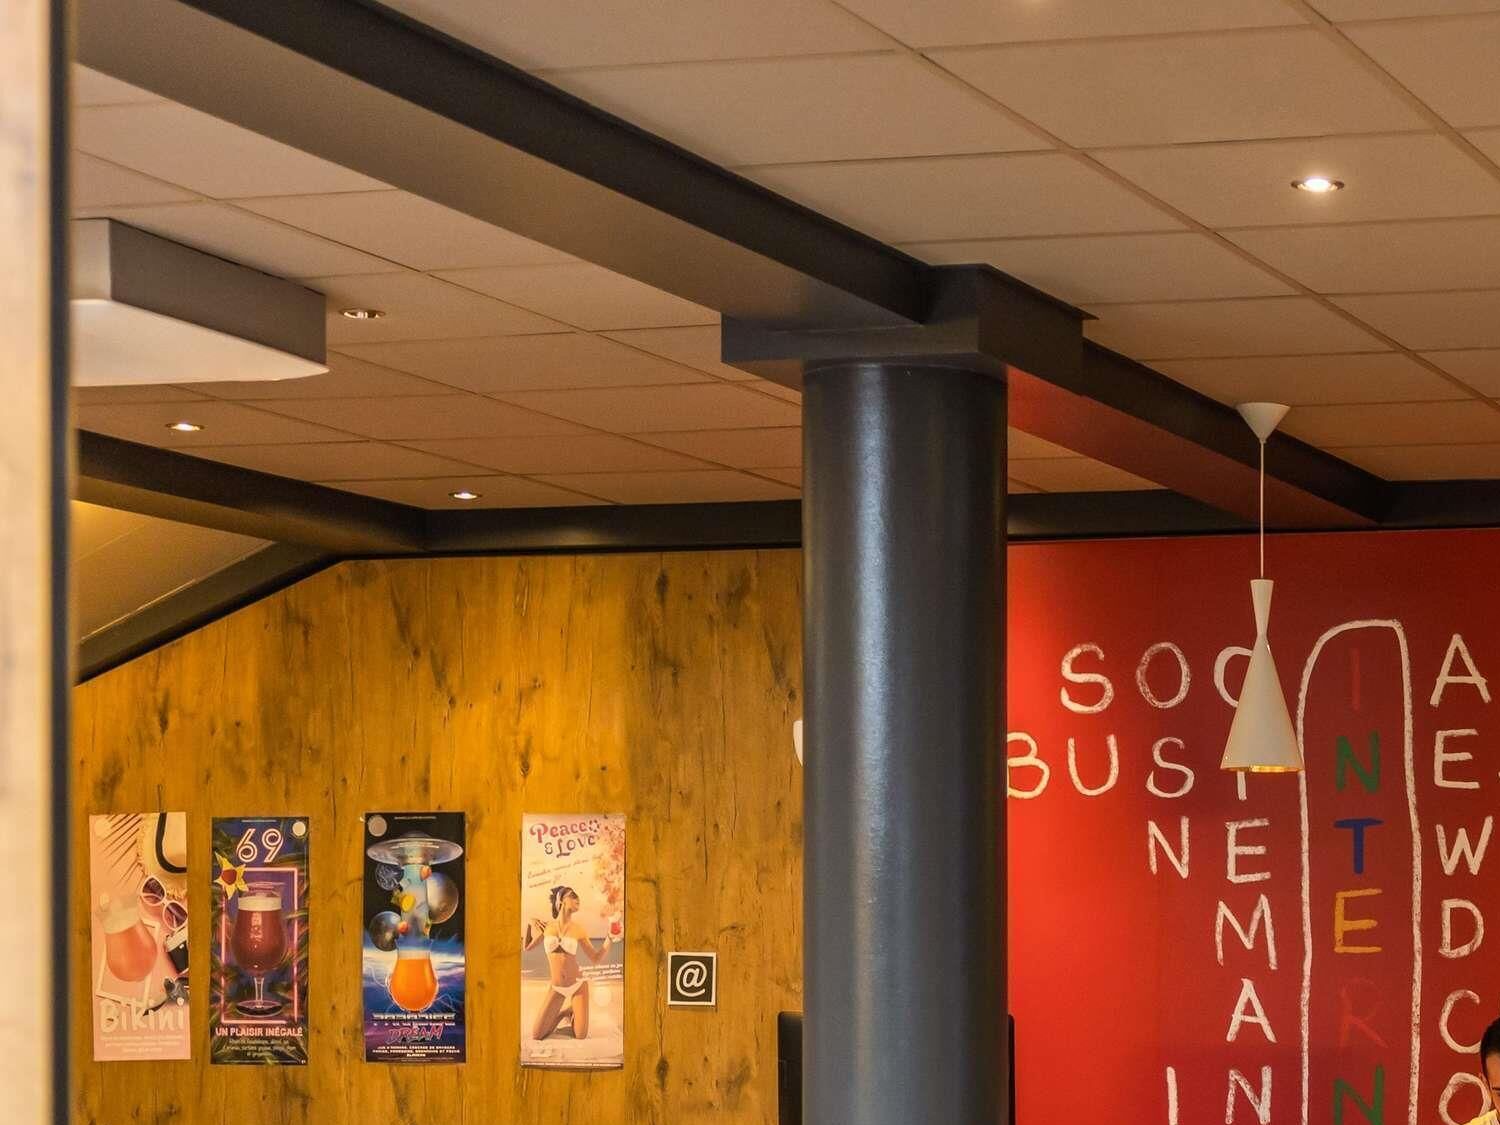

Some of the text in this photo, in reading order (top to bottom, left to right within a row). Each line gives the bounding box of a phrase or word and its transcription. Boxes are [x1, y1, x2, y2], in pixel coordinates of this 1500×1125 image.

[529, 822, 587, 843] Peace
[236, 828, 284, 863] 69
[215, 1026, 303, 1037] UN PLAISIR INÉGALÉ
